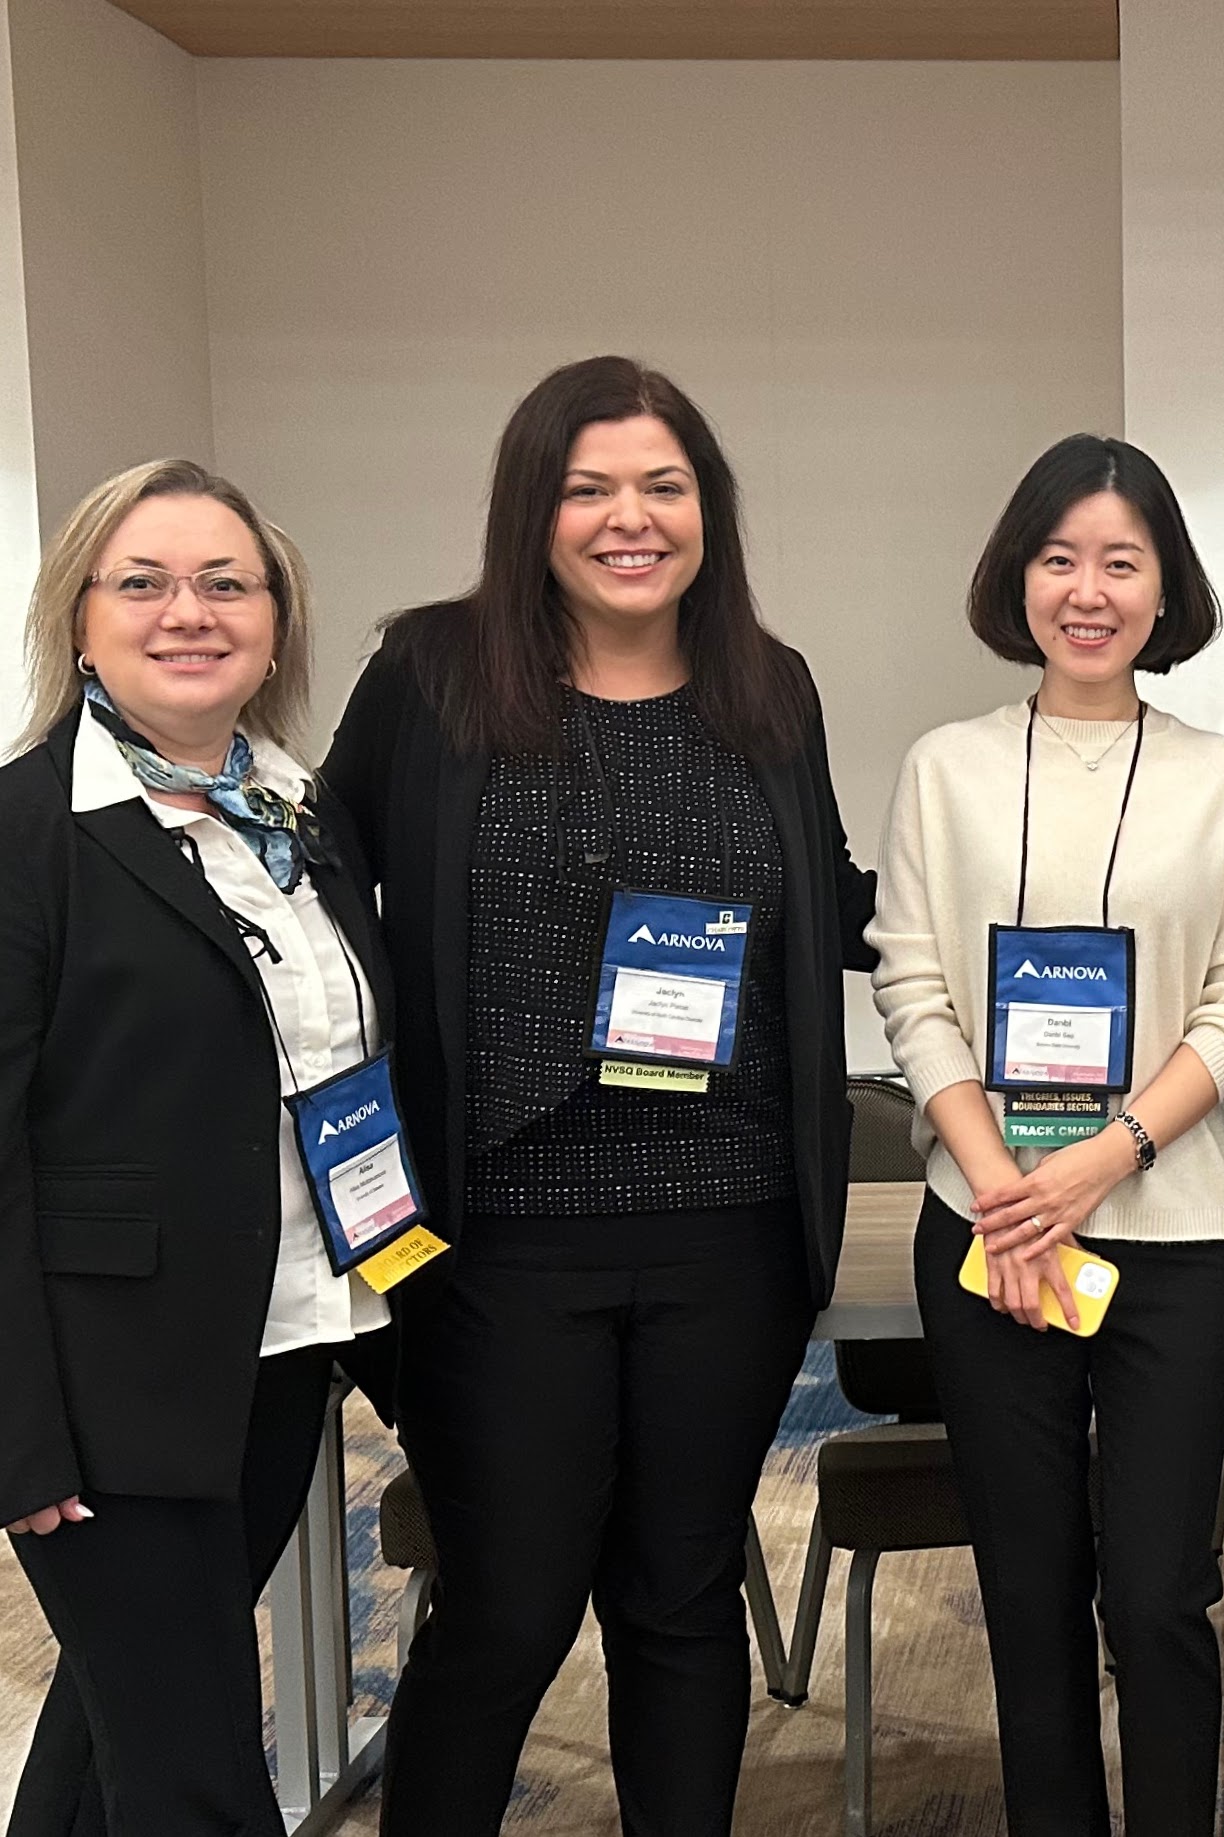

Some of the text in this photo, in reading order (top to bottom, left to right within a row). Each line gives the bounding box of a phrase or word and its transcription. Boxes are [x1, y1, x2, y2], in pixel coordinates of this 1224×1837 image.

[657, 932, 726, 952] ARNOVA
[1040, 965, 1107, 981] ARNOVA
[656, 987, 685, 999] Jaclyn
[1047, 1018, 1072, 1028] Danbi
[604, 1064, 705, 1081] NVSQ Board Member
[1062, 1093, 1094, 1103] ISSUES,
[1011, 1101, 1101, 1112] BOUNDARIES SECTION
[337, 1099, 381, 1134] ARNOVA
[1010, 1124, 1056, 1137] TRACK
[409, 1237, 425, 1254] OF
